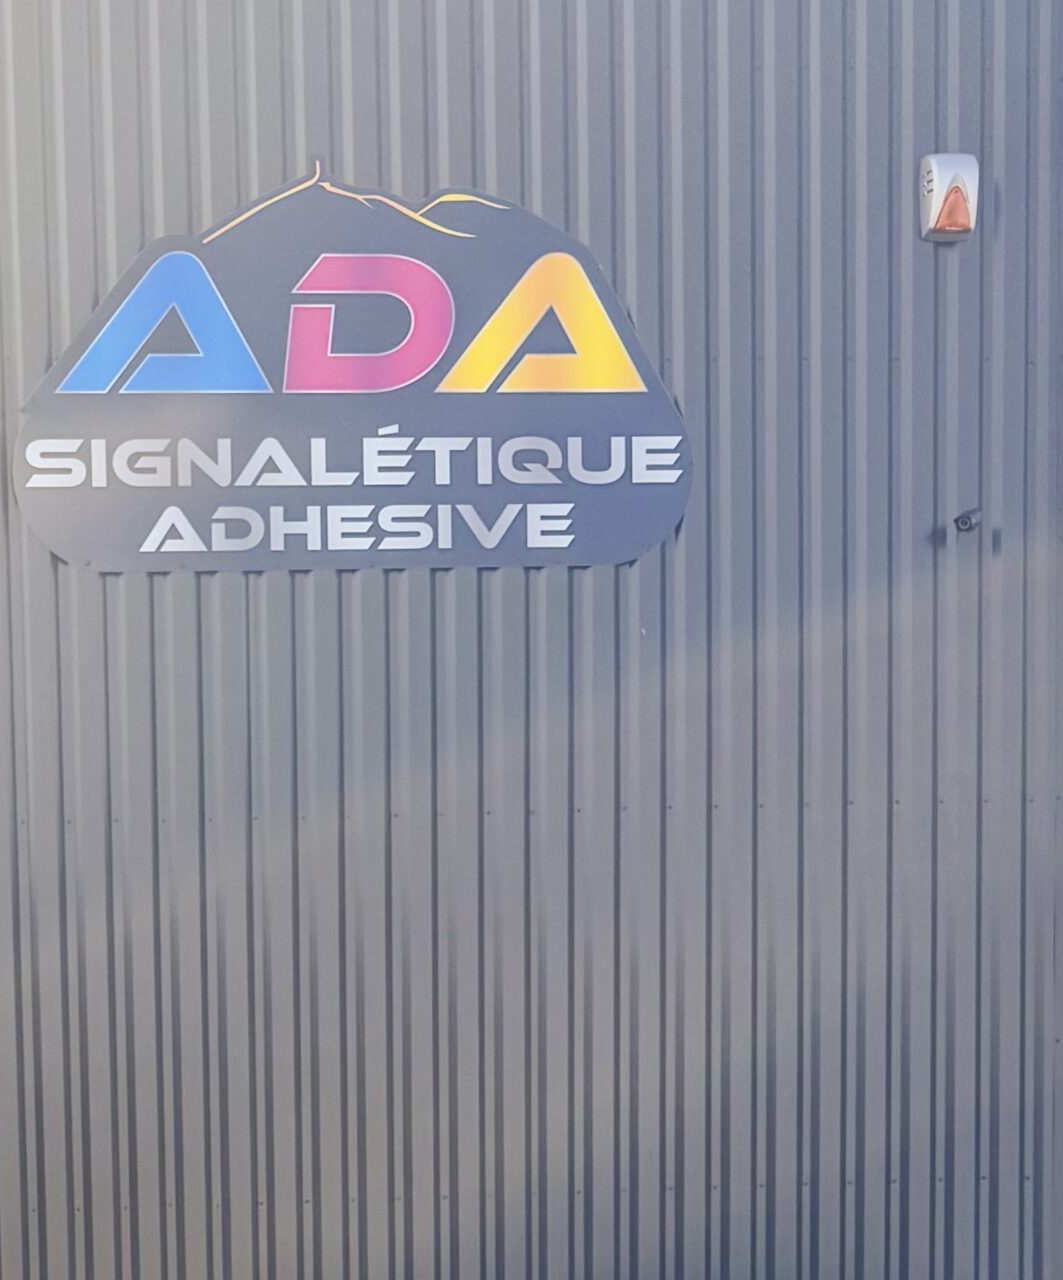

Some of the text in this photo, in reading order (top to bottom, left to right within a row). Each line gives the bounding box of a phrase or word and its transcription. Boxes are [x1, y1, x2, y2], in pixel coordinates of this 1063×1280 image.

[54, 250, 649, 394] ADA
[24, 423, 684, 488] SIGNALÉTIQUE
[138, 502, 576, 553] ADHESIVE
